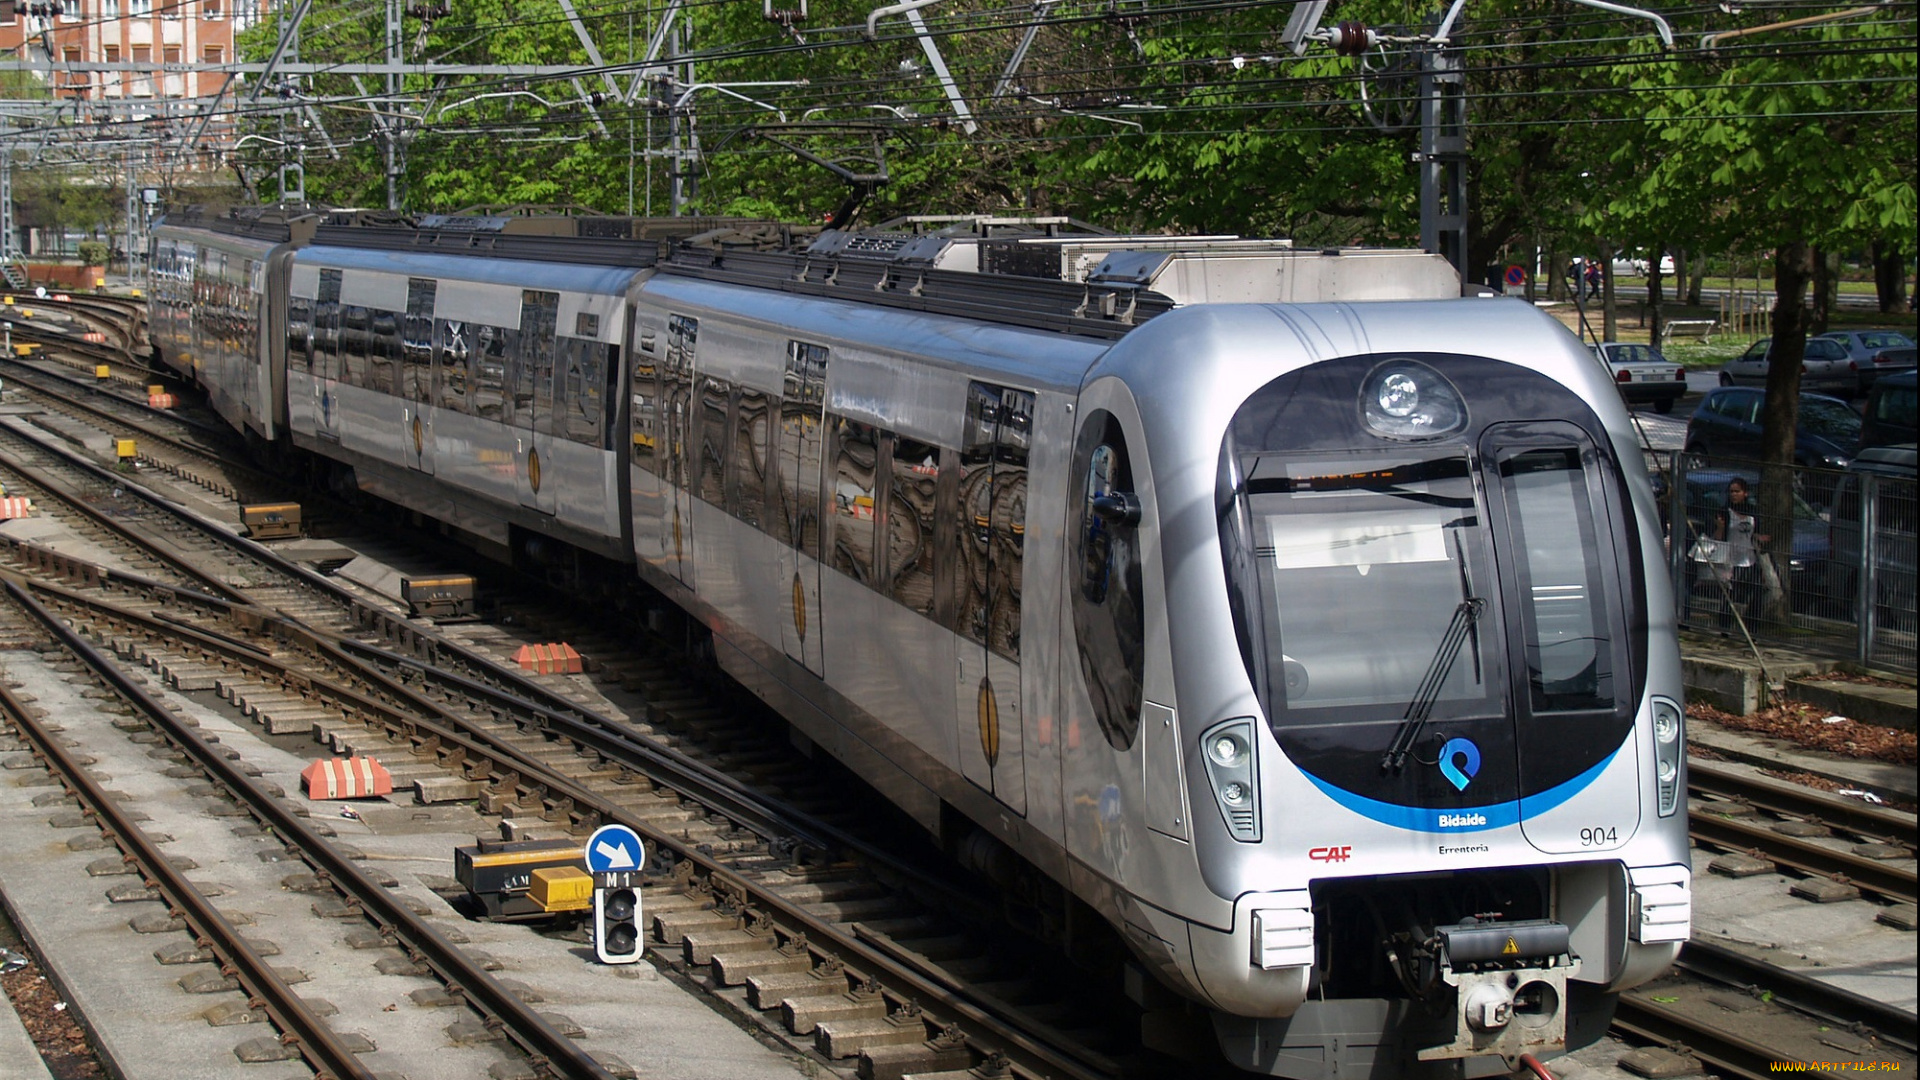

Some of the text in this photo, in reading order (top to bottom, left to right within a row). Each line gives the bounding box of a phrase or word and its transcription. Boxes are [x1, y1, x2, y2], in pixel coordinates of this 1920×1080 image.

[1438, 813, 1487, 828] Bidaide
[1580, 826, 1618, 847] 904
[1308, 846, 1352, 863] CAF
[1438, 843, 1489, 855] Errenteria
